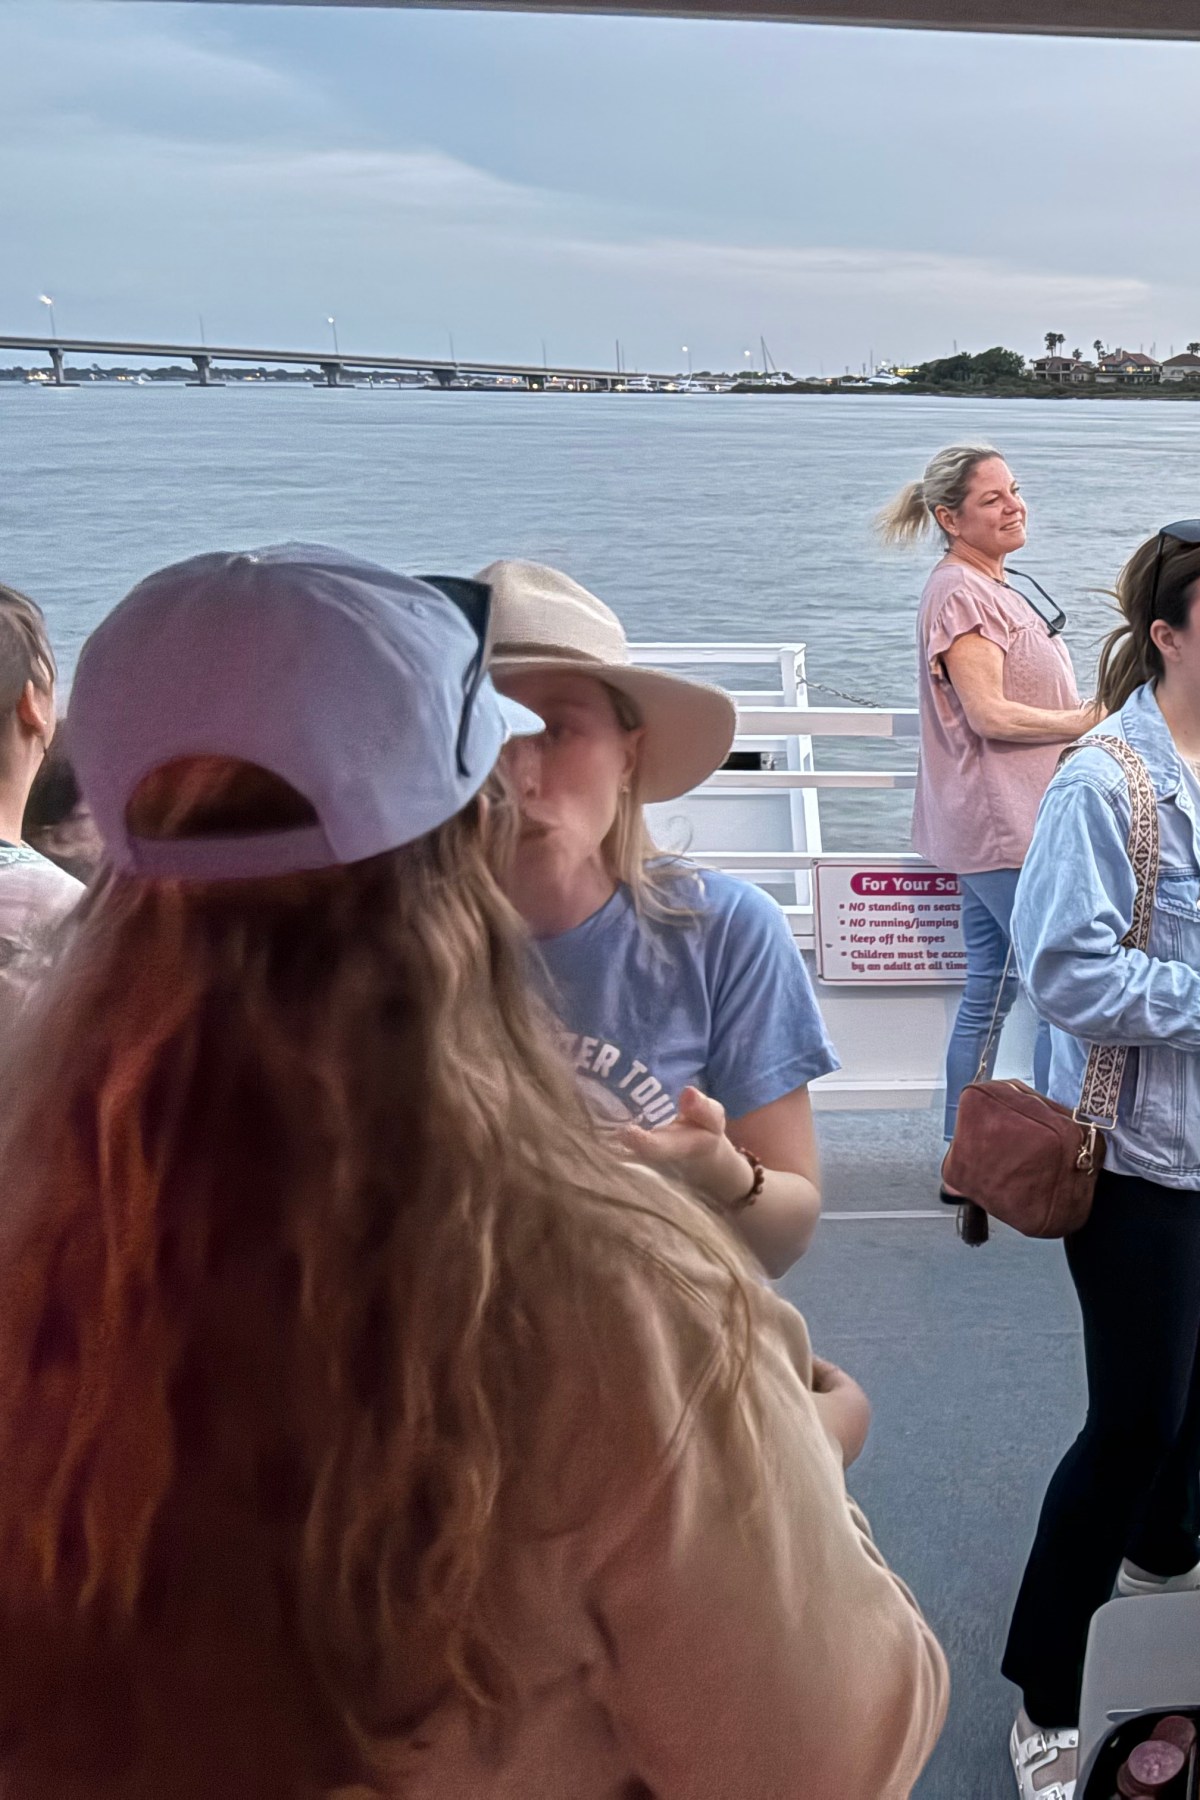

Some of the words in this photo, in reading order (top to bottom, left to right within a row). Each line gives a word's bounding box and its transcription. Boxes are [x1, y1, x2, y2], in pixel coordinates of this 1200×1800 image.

[861, 877, 888, 891] For
[892, 877, 930, 891] Your
[849, 902, 866, 912] NO
[868, 902, 915, 913] standing
[917, 904, 931, 912] on
[933, 903, 962, 912] seats
[849, 918, 866, 928] NO
[869, 918, 960, 930] running/jumping
[850, 934, 877, 945] Keep
[878, 934, 895, 945] off
[897, 934, 914, 943] the
[917, 936, 946, 945] ropes
[851, 950, 895, 959] Children
[897, 951, 924, 959] must
[927, 950, 939, 959] be
[851, 962, 865, 972] by
[883, 962, 912, 970] adult
[928, 961, 943, 970] all
[945, 961, 968, 970] time
